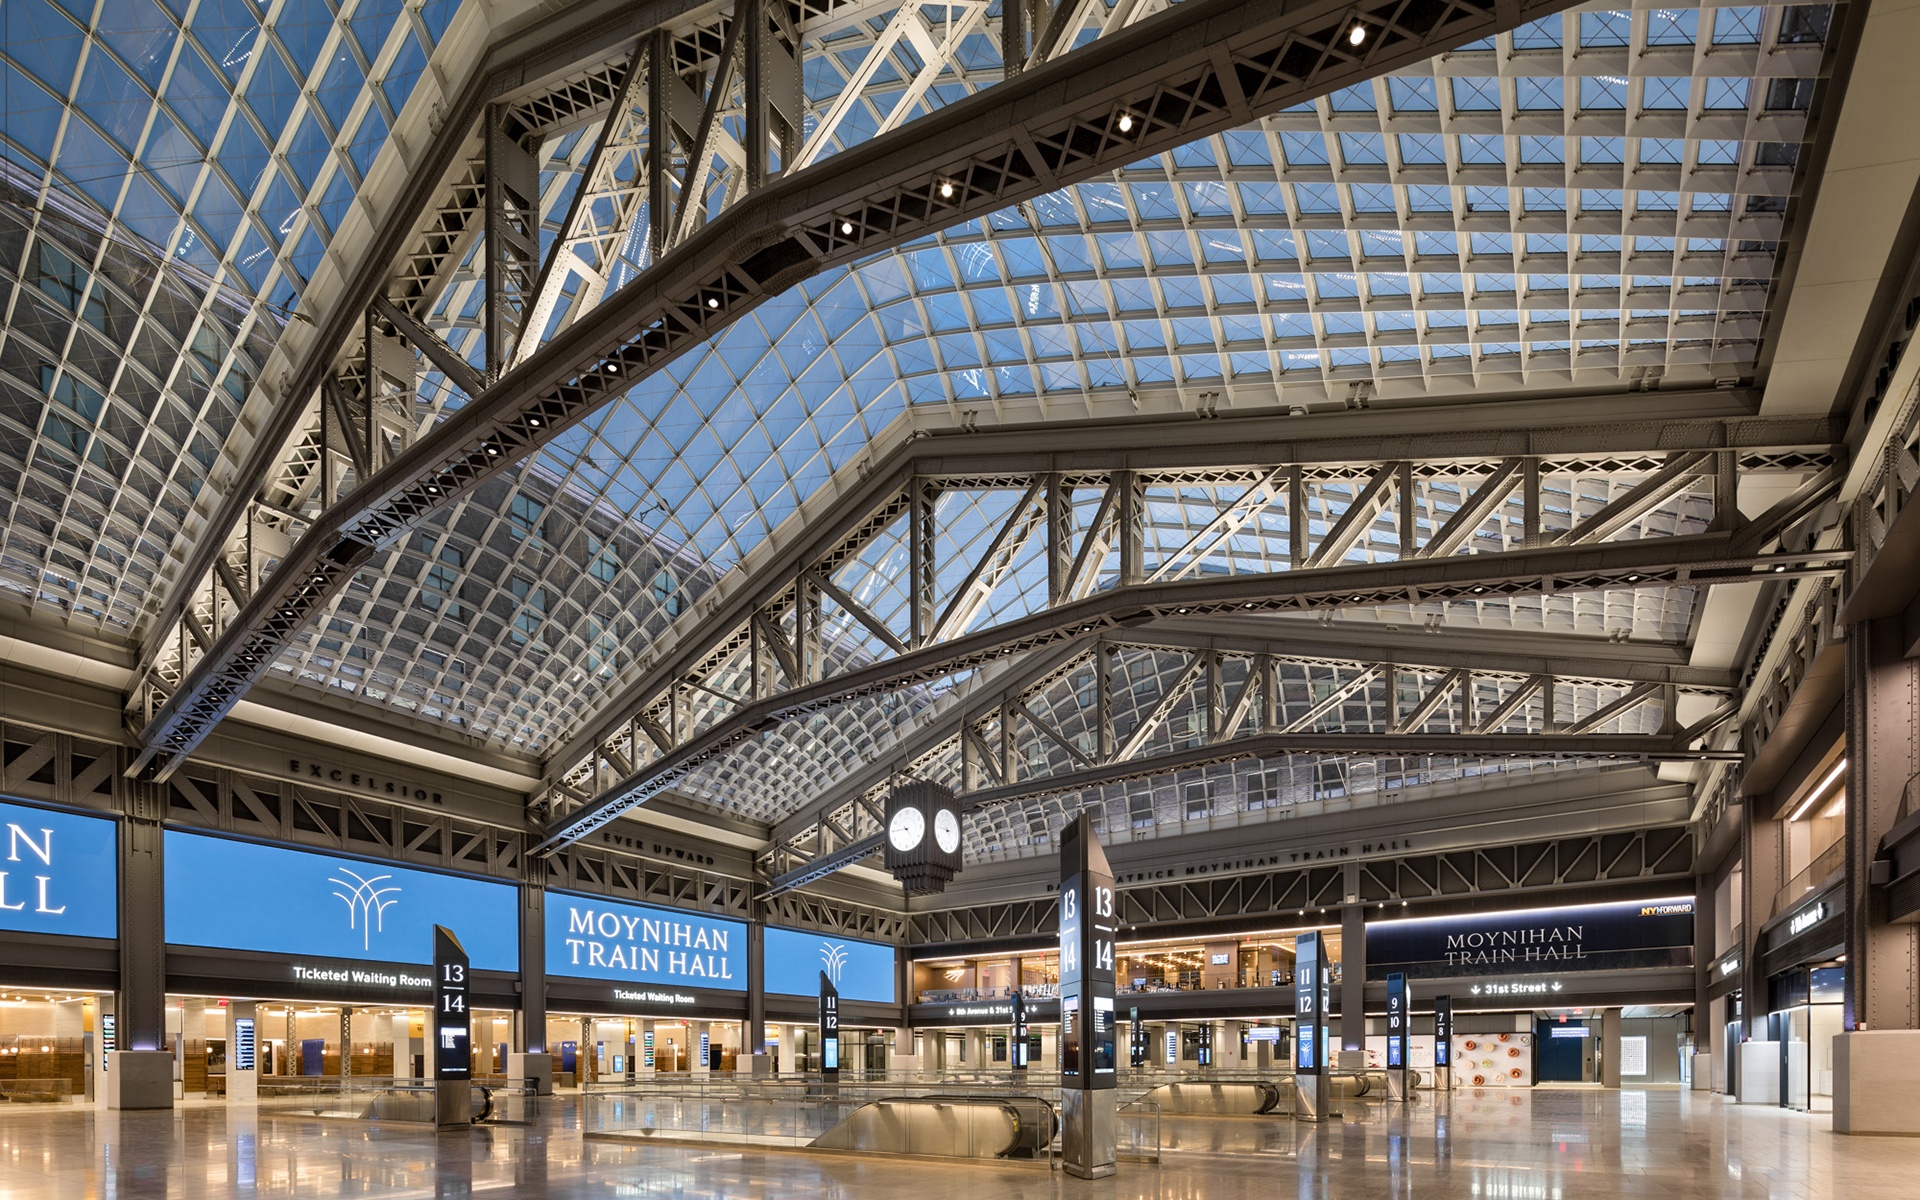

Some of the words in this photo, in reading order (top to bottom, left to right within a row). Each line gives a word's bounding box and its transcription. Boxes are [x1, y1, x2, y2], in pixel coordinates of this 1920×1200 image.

[290, 759, 444, 805] EXCELSIOR
[603, 833, 644, 850] EVER
[653, 844, 715, 866] UPWARD
[1116, 868, 1176, 884] ATRICK
[1185, 855, 1279, 875] MOYNIHAN
[1290, 847, 1349, 862] TRAIN
[1362, 839, 1412, 853] HALL
[1063, 888, 1076, 921] 13
[1094, 885, 1113, 918] 13
[1641, 907, 1657, 916] NY
[1659, 904, 1692, 914] FORWARD
[568, 907, 729, 952] MOYNIHAN
[1446, 925, 1584, 949] MOYNIHAN
[565, 938, 660, 972] TRAIN
[668, 951, 733, 979] HALL
[1064, 941, 1076, 973] 14
[1094, 938, 1113, 971] 14
[1444, 948, 1516, 966] TRAIN
[1525, 944, 1588, 961] HALL
[293, 966, 349, 982] Ticketed
[351, 970, 397, 987] Waiting
[399, 974, 432, 988] Room
[442, 963, 465, 983] 13
[1300, 968, 1311, 985] 11
[613, 989, 646, 1001] Ticketed
[647, 991, 675, 1004] Waiting
[674, 994, 695, 1004] Room
[1485, 984, 1509, 995] 31st
[1511, 982, 1547, 993] Street
[442, 994, 466, 1013] 14
[826, 995, 836, 1009] 11
[1300, 995, 1312, 1013] 12
[1391, 997, 1398, 1009] 9
[826, 1016, 837, 1029] 12
[1390, 1016, 1400, 1028] 10
[1438, 1012, 1444, 1022] 7
[1438, 1026, 1444, 1036] 8
